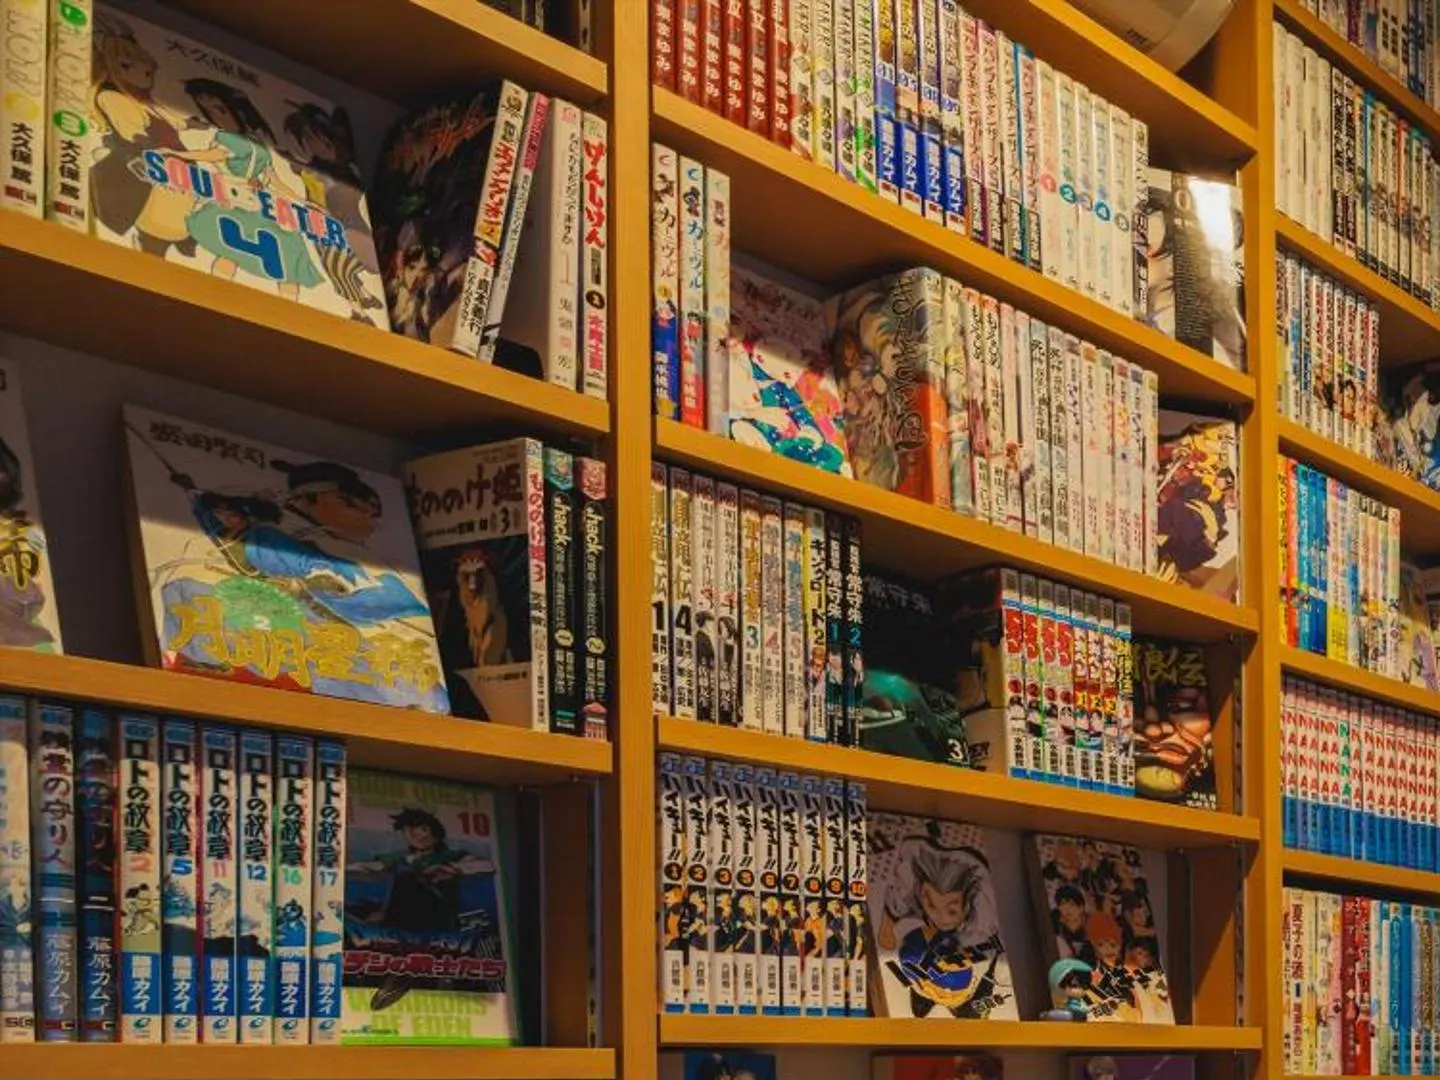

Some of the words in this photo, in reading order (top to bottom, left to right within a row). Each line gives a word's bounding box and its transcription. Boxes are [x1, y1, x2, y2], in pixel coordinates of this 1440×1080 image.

[216, 213, 287, 280] 4
[129, 858, 151, 874] 2
[171, 859, 192, 875] 5
[211, 861, 227, 878] 11
[246, 864, 267, 881] 12
[282, 868, 303, 885] 16
[318, 870, 338, 887] 17
